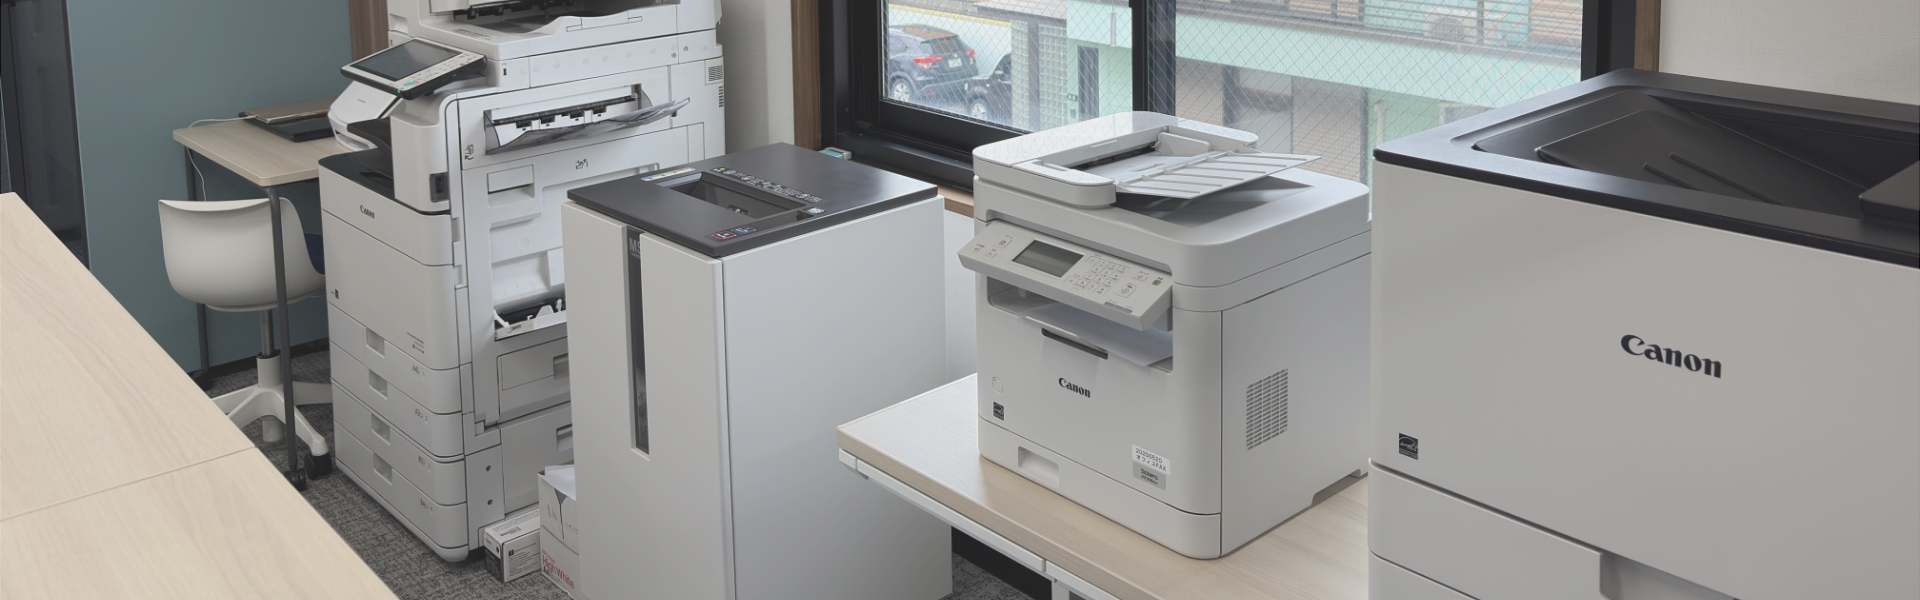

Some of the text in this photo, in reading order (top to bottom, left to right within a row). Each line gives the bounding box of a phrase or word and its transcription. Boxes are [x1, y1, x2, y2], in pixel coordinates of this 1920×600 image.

[360, 204, 375, 220] Canon
[1620, 334, 1722, 379] Canon
[1058, 377, 1091, 398] Canon
[542, 555, 556, 573] High
[555, 566, 574, 589] White
